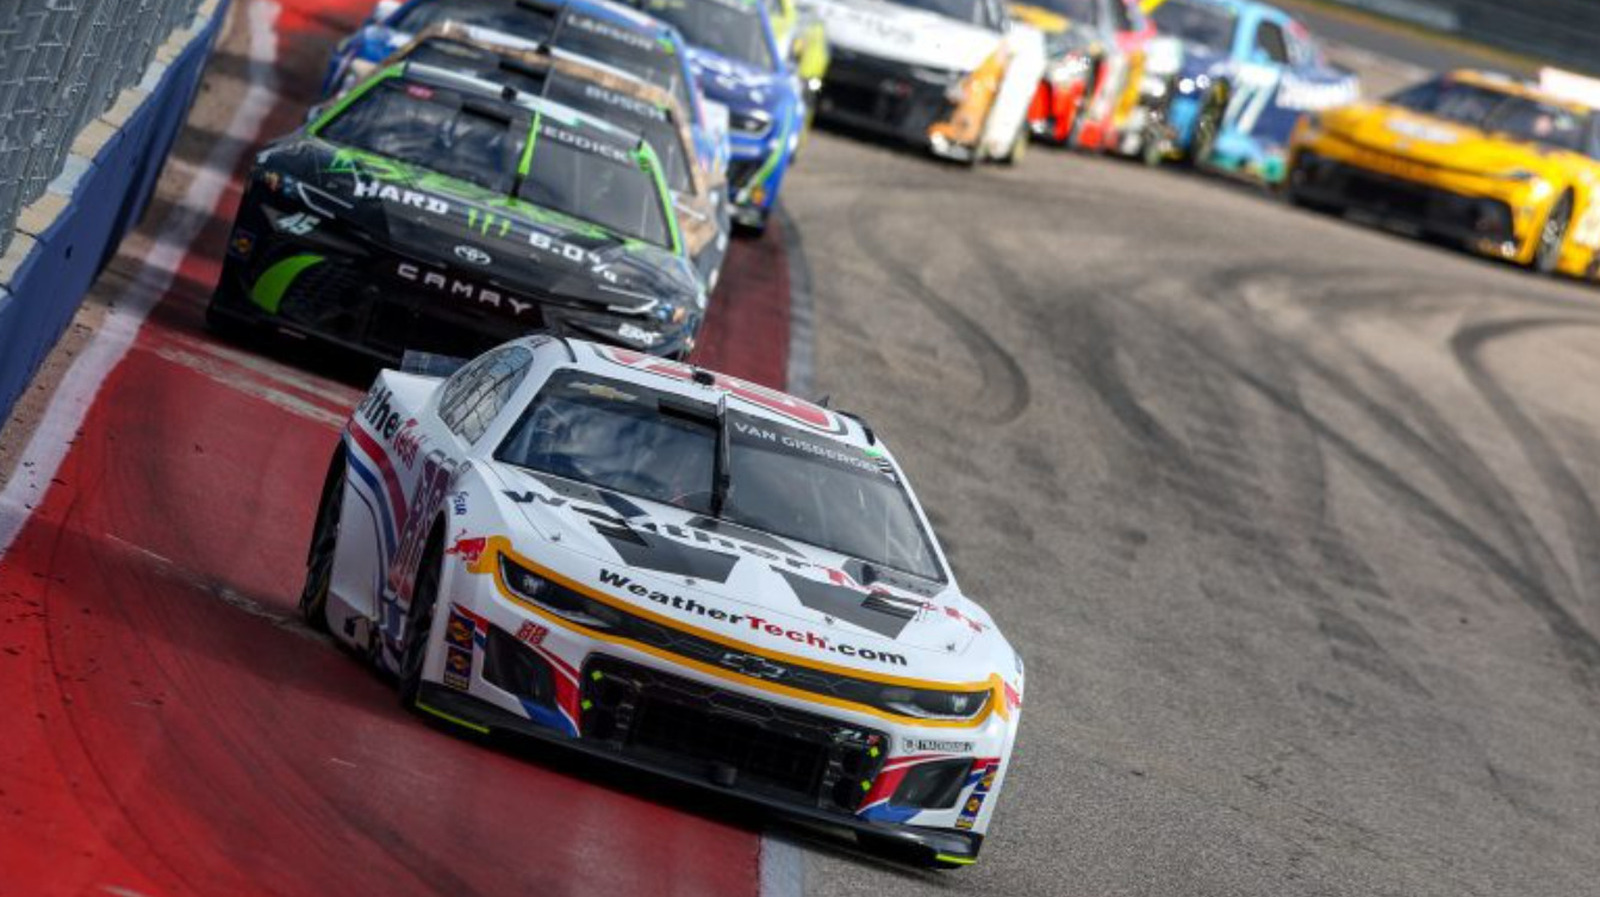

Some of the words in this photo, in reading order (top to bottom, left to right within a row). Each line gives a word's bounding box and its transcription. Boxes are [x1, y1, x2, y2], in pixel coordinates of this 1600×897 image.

[586, 85, 666, 121] BUSCH
[354, 181, 449, 214] HARD
[278, 212, 320, 236] 45
[528, 231, 617, 282] 6.0%
[397, 264, 532, 313] CAMRY
[734, 421, 776, 442] VAN
[515, 618, 549, 646] 88
[600, 568, 908, 666] WeatherTech.com
